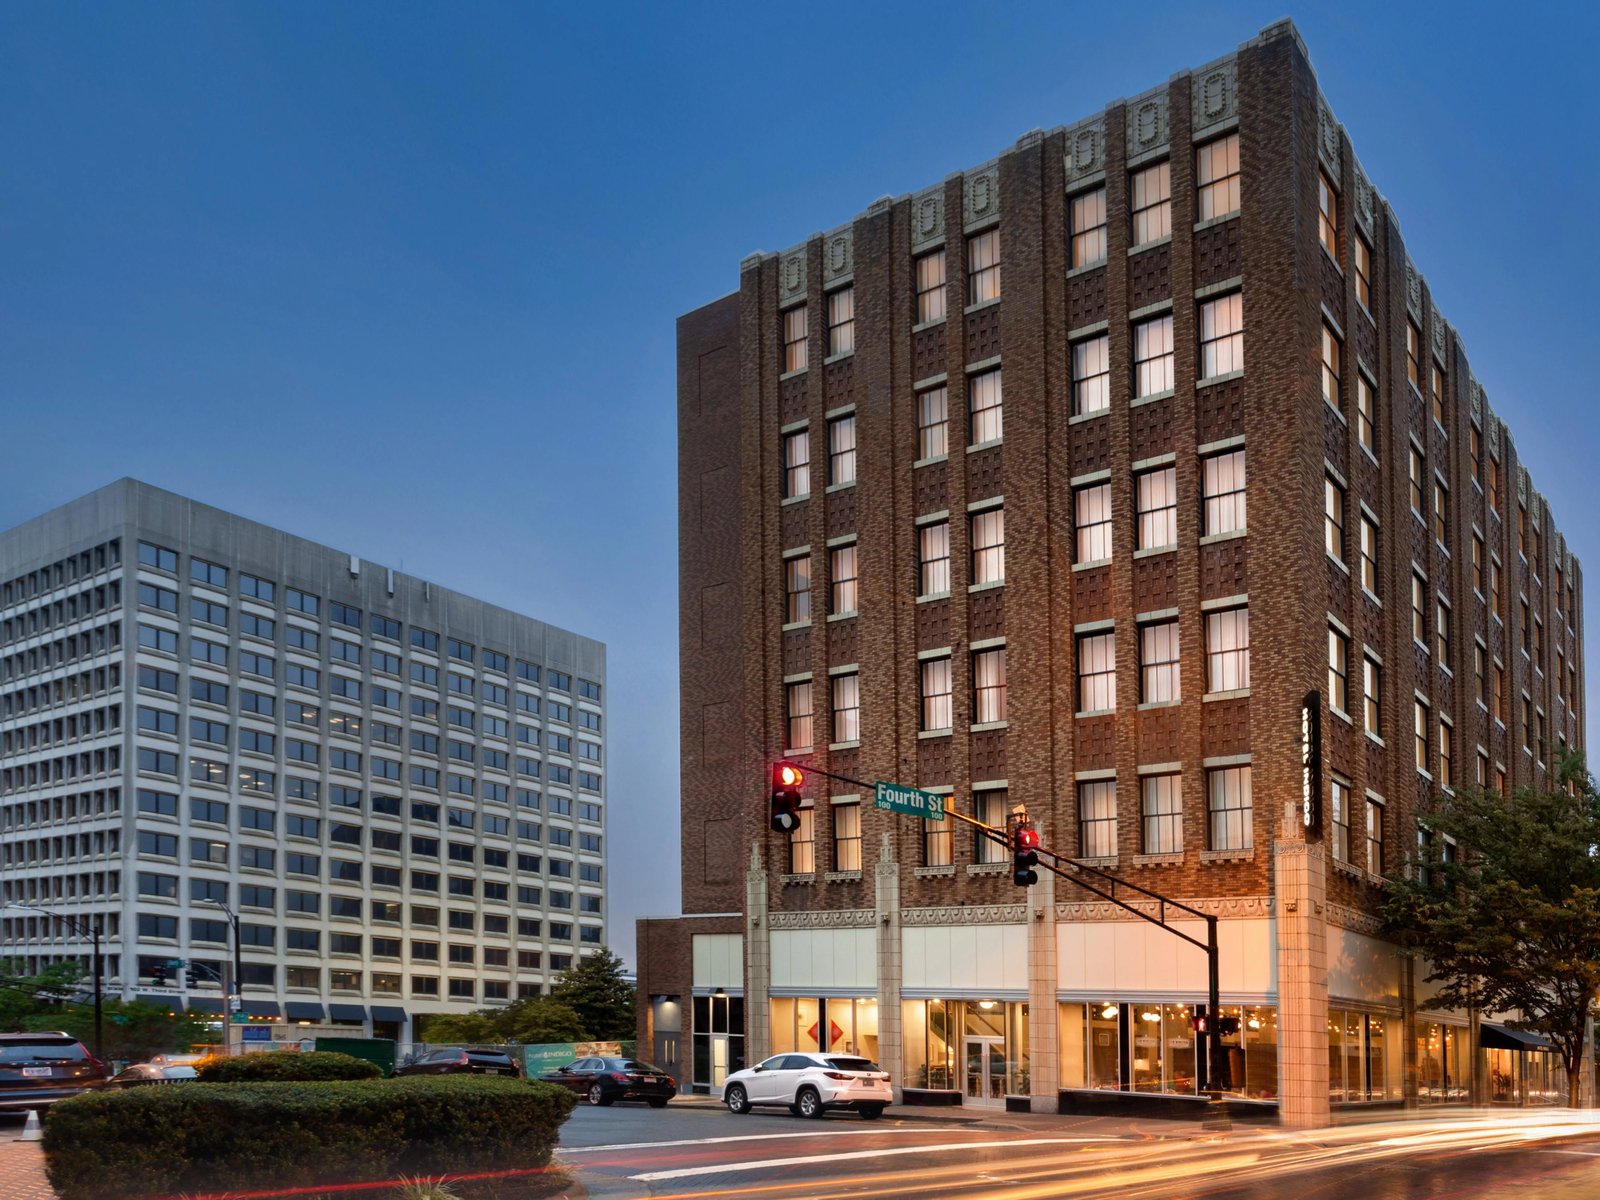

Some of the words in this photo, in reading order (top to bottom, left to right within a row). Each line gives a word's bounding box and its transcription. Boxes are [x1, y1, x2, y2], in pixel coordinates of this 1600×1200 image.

[877, 783, 924, 809] Fourth
[928, 795, 943, 812] St
[878, 801, 891, 809] 100
[931, 812, 942, 820] 100
